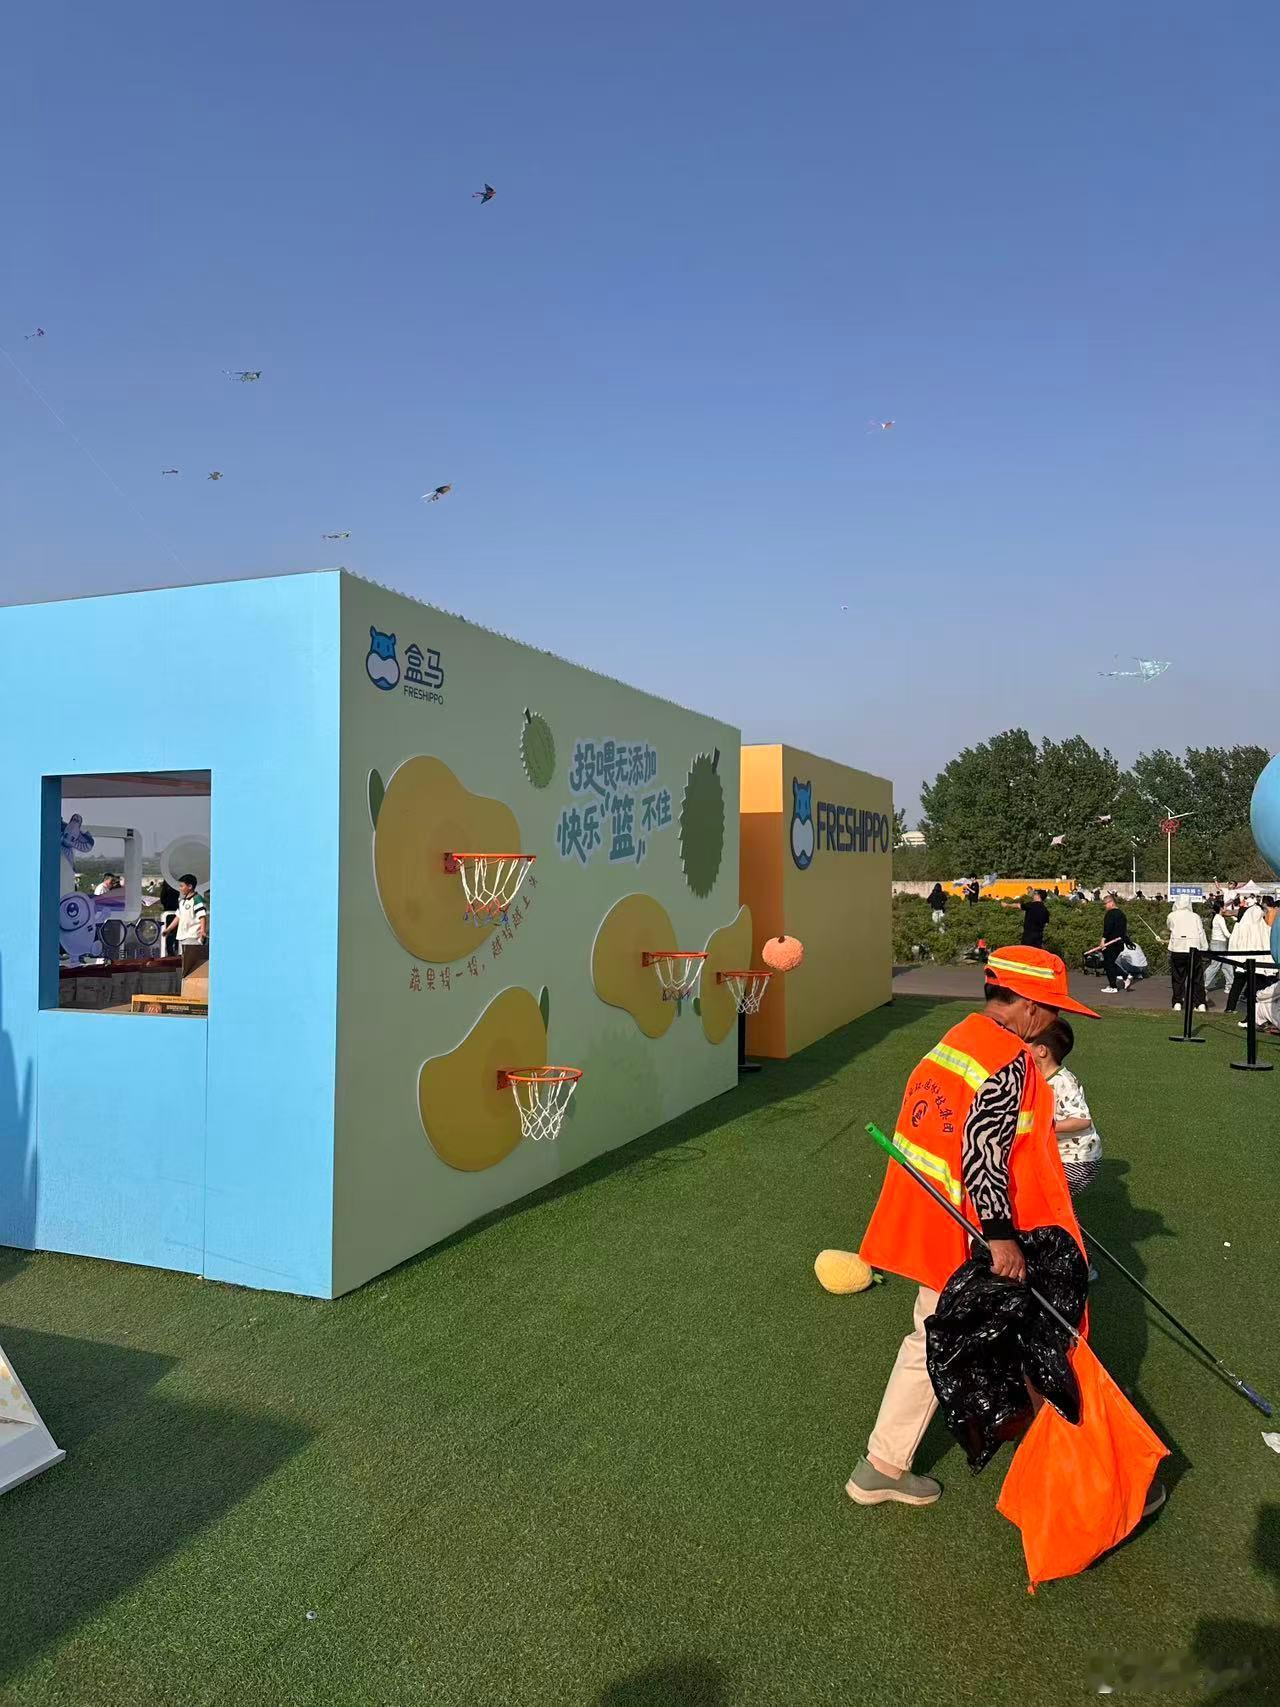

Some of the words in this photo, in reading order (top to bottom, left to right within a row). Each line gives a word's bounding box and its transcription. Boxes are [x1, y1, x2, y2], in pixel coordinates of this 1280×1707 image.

[403, 642, 444, 689] 盒马
[403, 685, 444, 706] FRESHIPPO
[569, 740, 657, 797] 投喂无添加
[817, 801, 890, 854] FRESHIPPO
